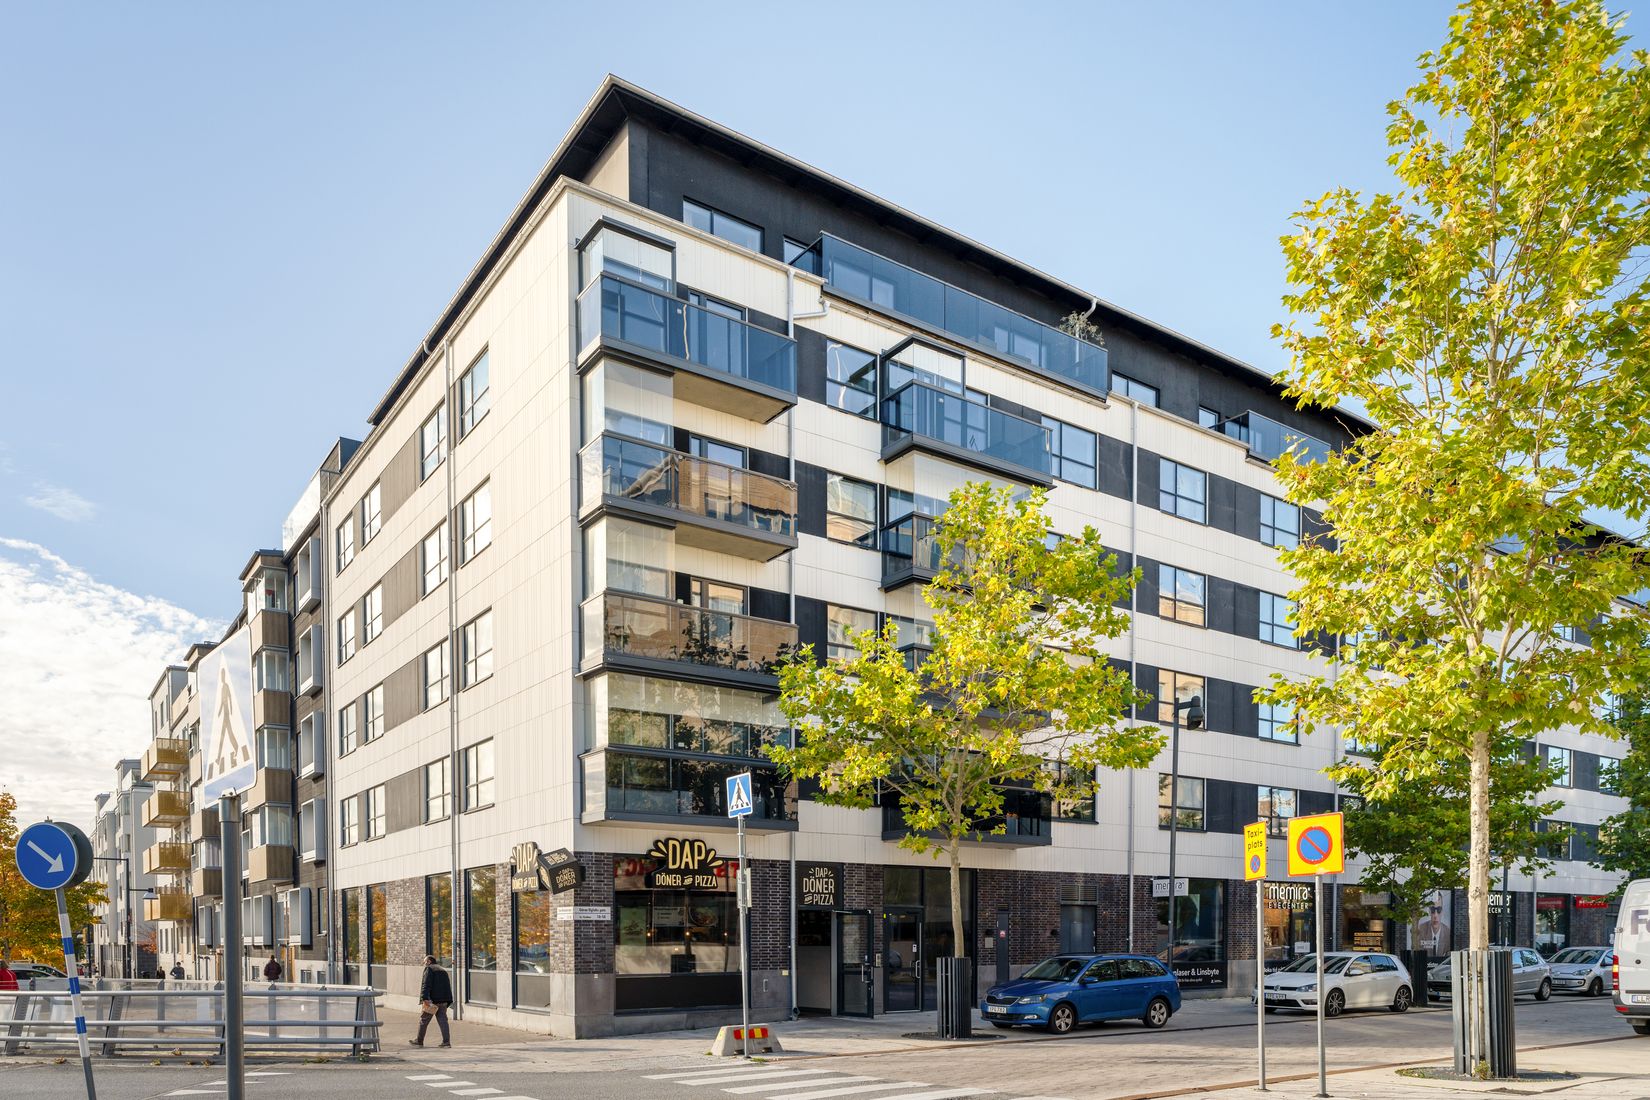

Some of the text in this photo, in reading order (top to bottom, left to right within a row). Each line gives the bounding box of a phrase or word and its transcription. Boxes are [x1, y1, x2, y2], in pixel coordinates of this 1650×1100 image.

[1247, 828, 1263, 839] Taxi-
[1247, 840, 1263, 851] plats
[516, 843, 533, 873] DAP
[668, 839, 706, 870] DAP
[555, 872, 576, 884] DÖNER
[815, 867, 829, 878] DAP
[563, 879, 577, 887] PIZZA
[655, 872, 682, 886] DÖNER
[694, 875, 717, 887] PIZZA
[803, 876, 835, 894] DÖNER
[813, 893, 835, 905] PIZZA
[1268, 886, 1309, 900] memira
[1268, 901, 1309, 910] EYECENTER
[1196, 967, 1220, 977] Linsbyte
